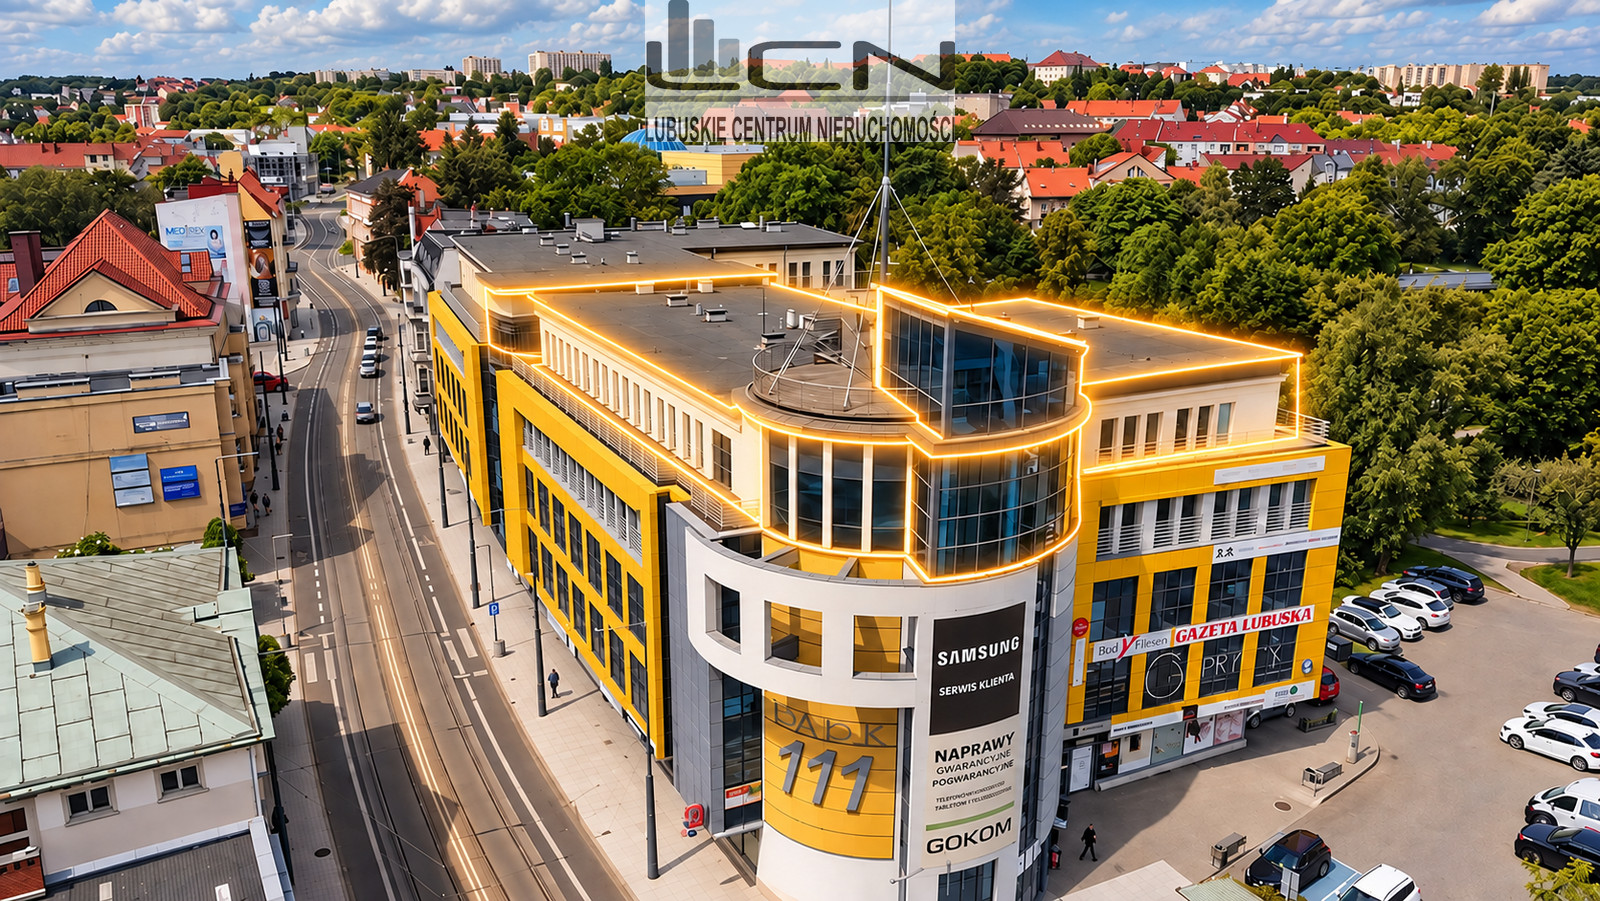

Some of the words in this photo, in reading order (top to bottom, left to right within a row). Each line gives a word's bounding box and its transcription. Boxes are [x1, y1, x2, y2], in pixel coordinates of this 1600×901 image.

[1176, 619, 1238, 643] GAZETA
[1242, 607, 1312, 631] LUBUSKA
[937, 635, 1020, 667] SAMSUNG
[938, 683, 977, 697] SERWIS
[979, 672, 1015, 690] KLIENTA
[934, 731, 1016, 763] NAPRAWY
[936, 748, 1012, 775] GWARANCYJNE
[778, 739, 875, 812] 111
[932, 759, 1015, 788] POGWARANCYJNE
[926, 817, 1012, 855] GOKOM
